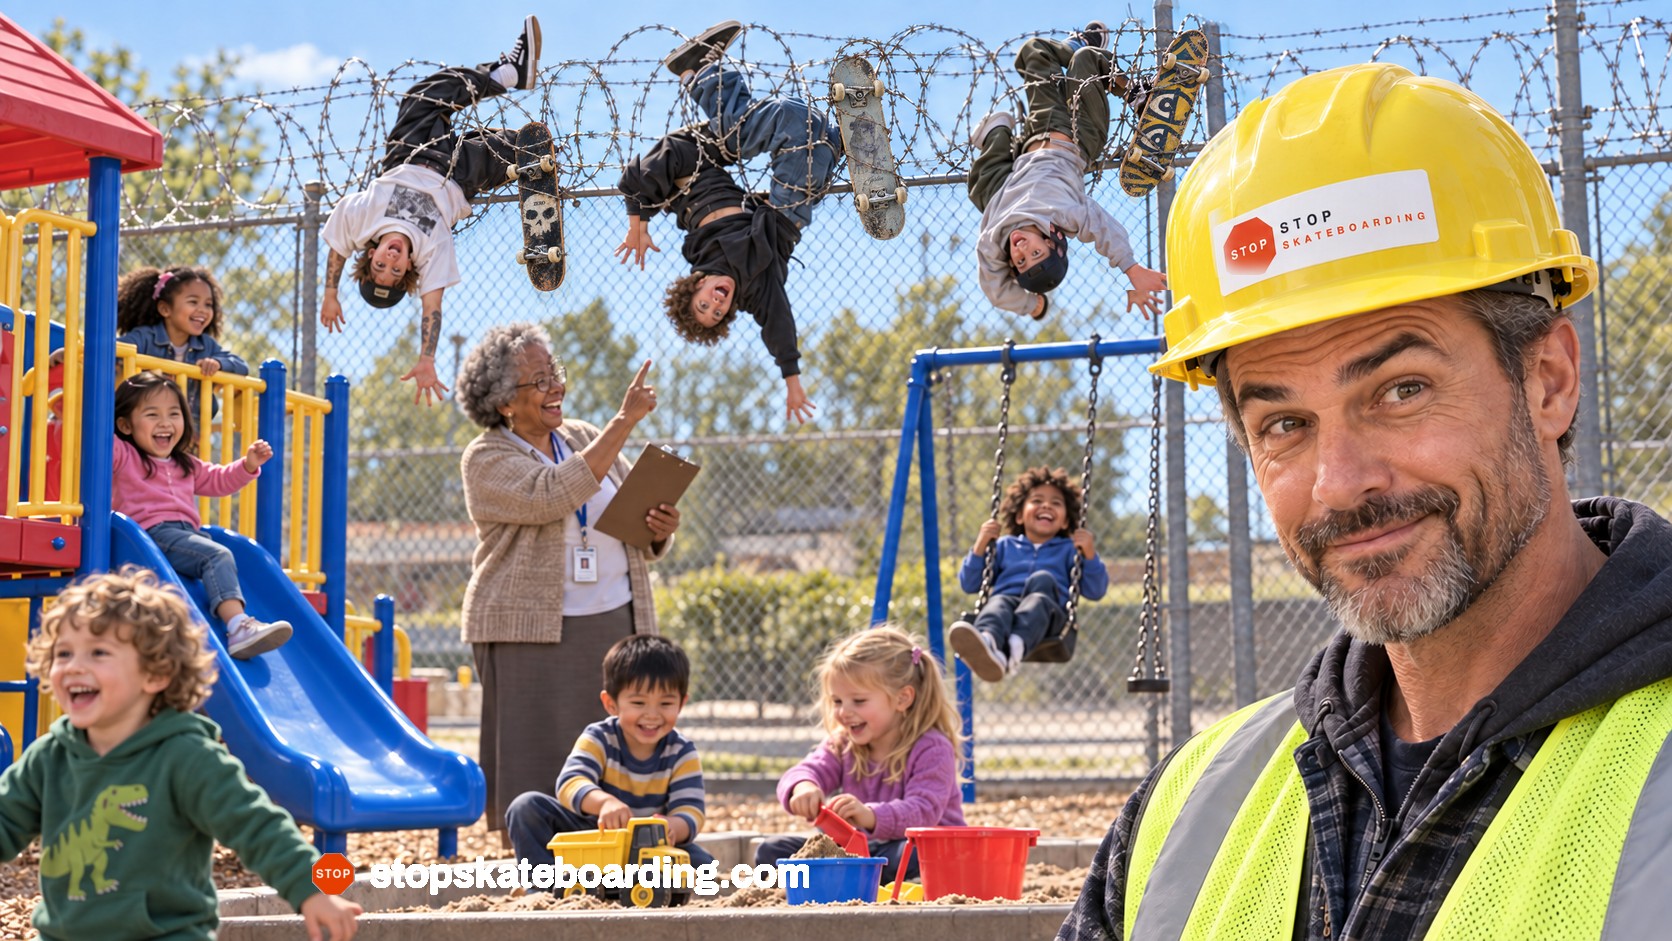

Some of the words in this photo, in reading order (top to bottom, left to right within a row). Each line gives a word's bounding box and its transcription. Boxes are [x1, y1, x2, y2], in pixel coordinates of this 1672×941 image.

[1280, 210, 1331, 234] STOP
[1282, 211, 1426, 250] SKATEBOARDING
[1231, 238, 1268, 260] STOP
